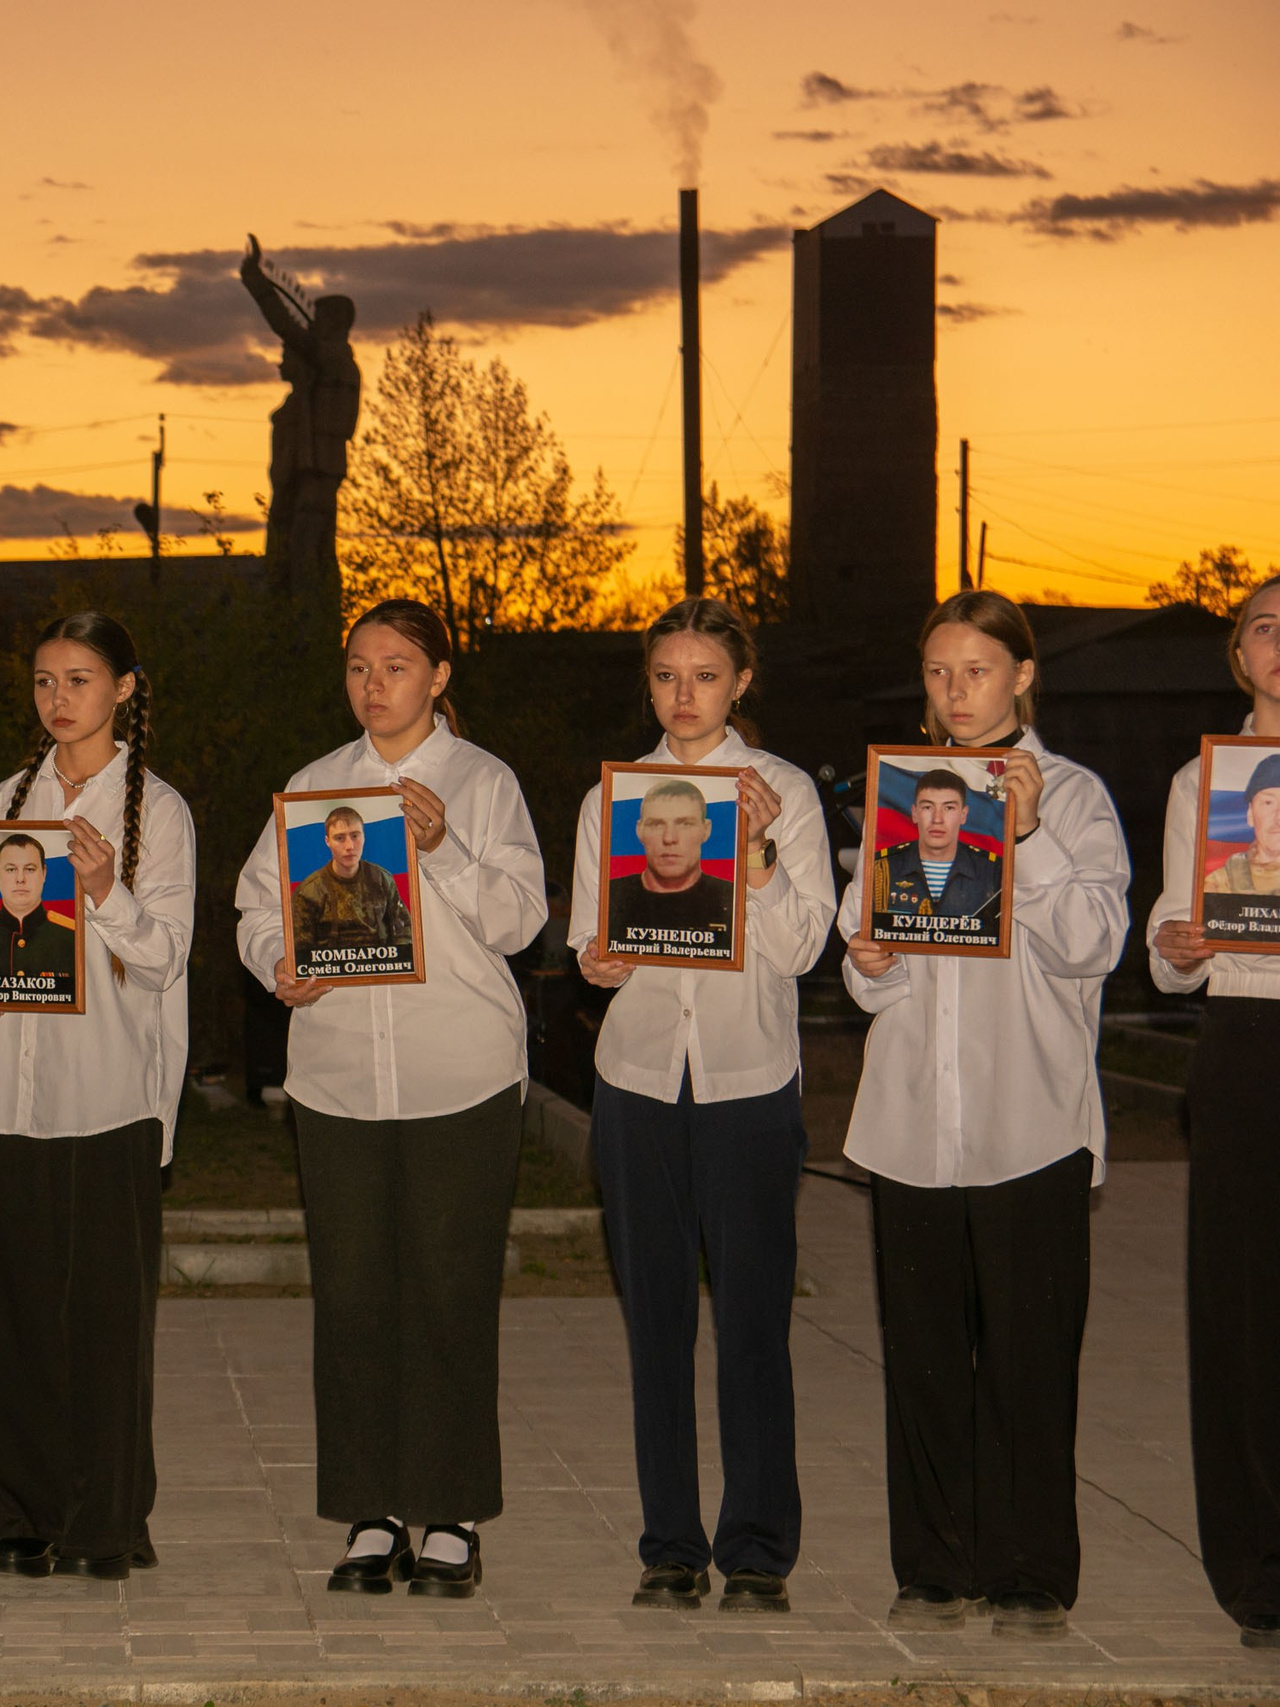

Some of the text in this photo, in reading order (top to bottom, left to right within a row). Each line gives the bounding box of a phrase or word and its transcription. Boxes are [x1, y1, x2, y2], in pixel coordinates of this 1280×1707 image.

[1239, 907, 1280, 919] ЛИХА
[892, 915, 982, 931] КУНДЕРЁВ
[1207, 919, 1245, 933] Фёдор
[626, 927, 715, 945] КУЗНЕЦОВ
[874, 928, 997, 945] Виталий Олегович
[311, 946, 398, 962] КОМБАРОВ
[608, 941, 730, 958] Дмитрий Валерьевич
[297, 962, 411, 975] Семён Олегович
[12, 990, 71, 1004] Викторович
